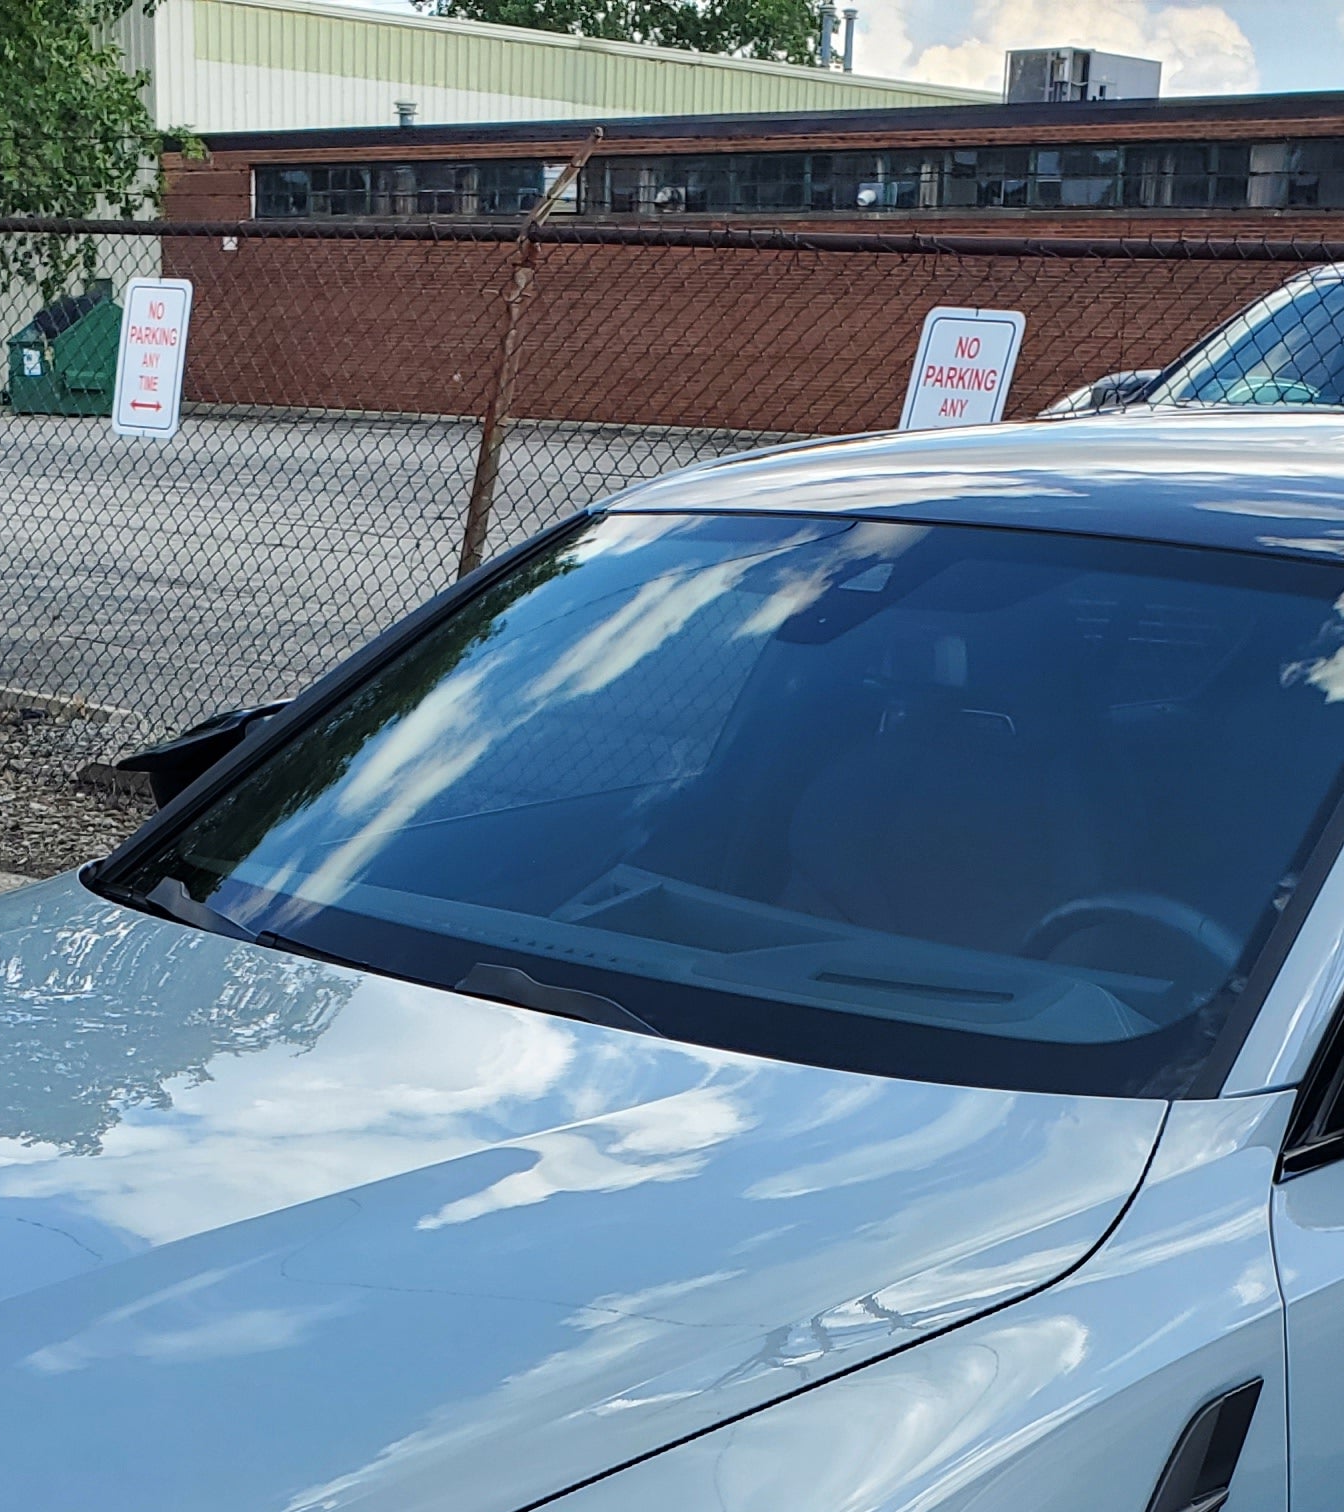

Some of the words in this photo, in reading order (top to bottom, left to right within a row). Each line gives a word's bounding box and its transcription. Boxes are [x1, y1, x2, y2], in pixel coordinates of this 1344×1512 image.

[149, 301, 166, 320] NO
[129, 326, 177, 346] PARKING
[954, 336, 981, 360] NO
[142, 353, 160, 369] ANY
[139, 375, 159, 392] TIME
[922, 365, 998, 392] PARKING
[939, 398, 969, 418] ANY
